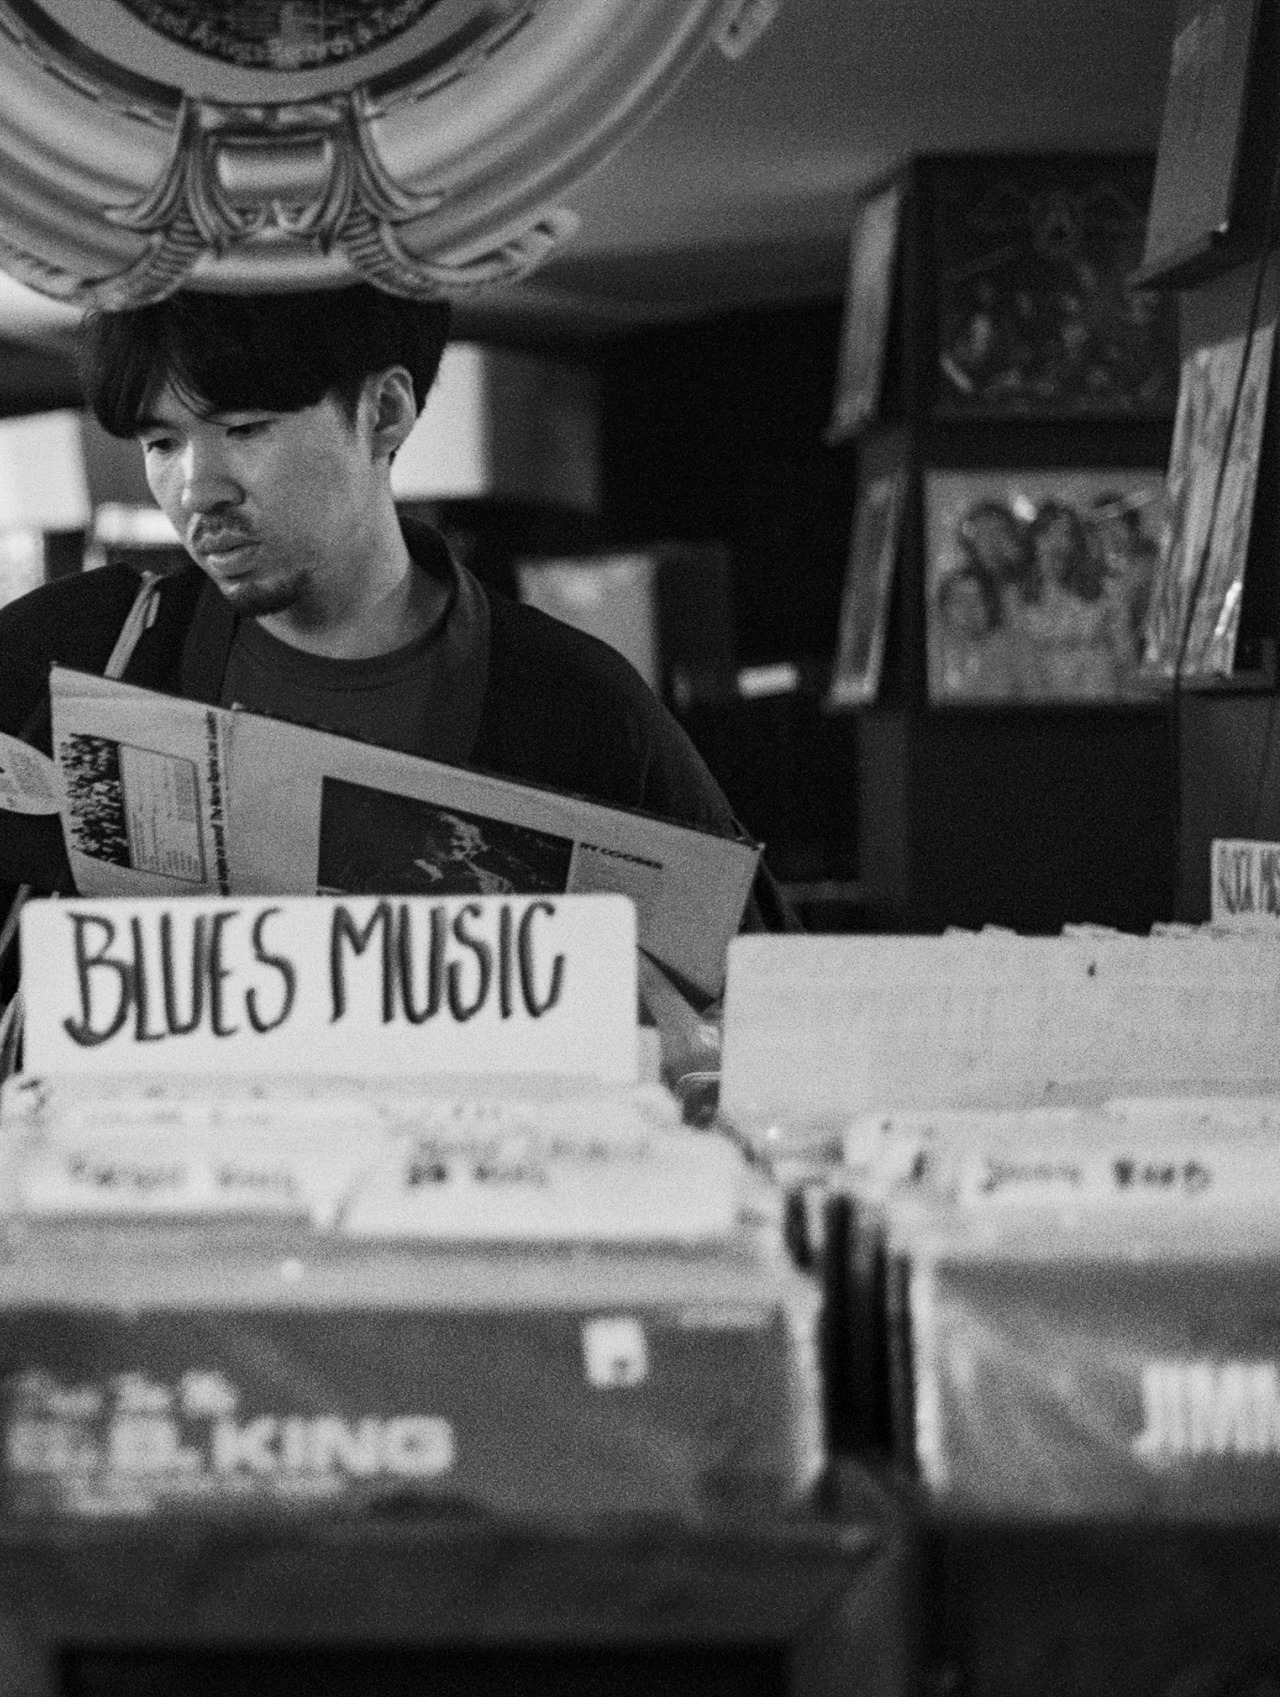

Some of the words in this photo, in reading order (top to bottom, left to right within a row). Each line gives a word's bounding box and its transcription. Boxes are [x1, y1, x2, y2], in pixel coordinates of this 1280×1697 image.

[63, 905, 298, 1047] BLUES
[329, 897, 566, 1025] MUSIC
[213, 1414, 456, 1474] KING
